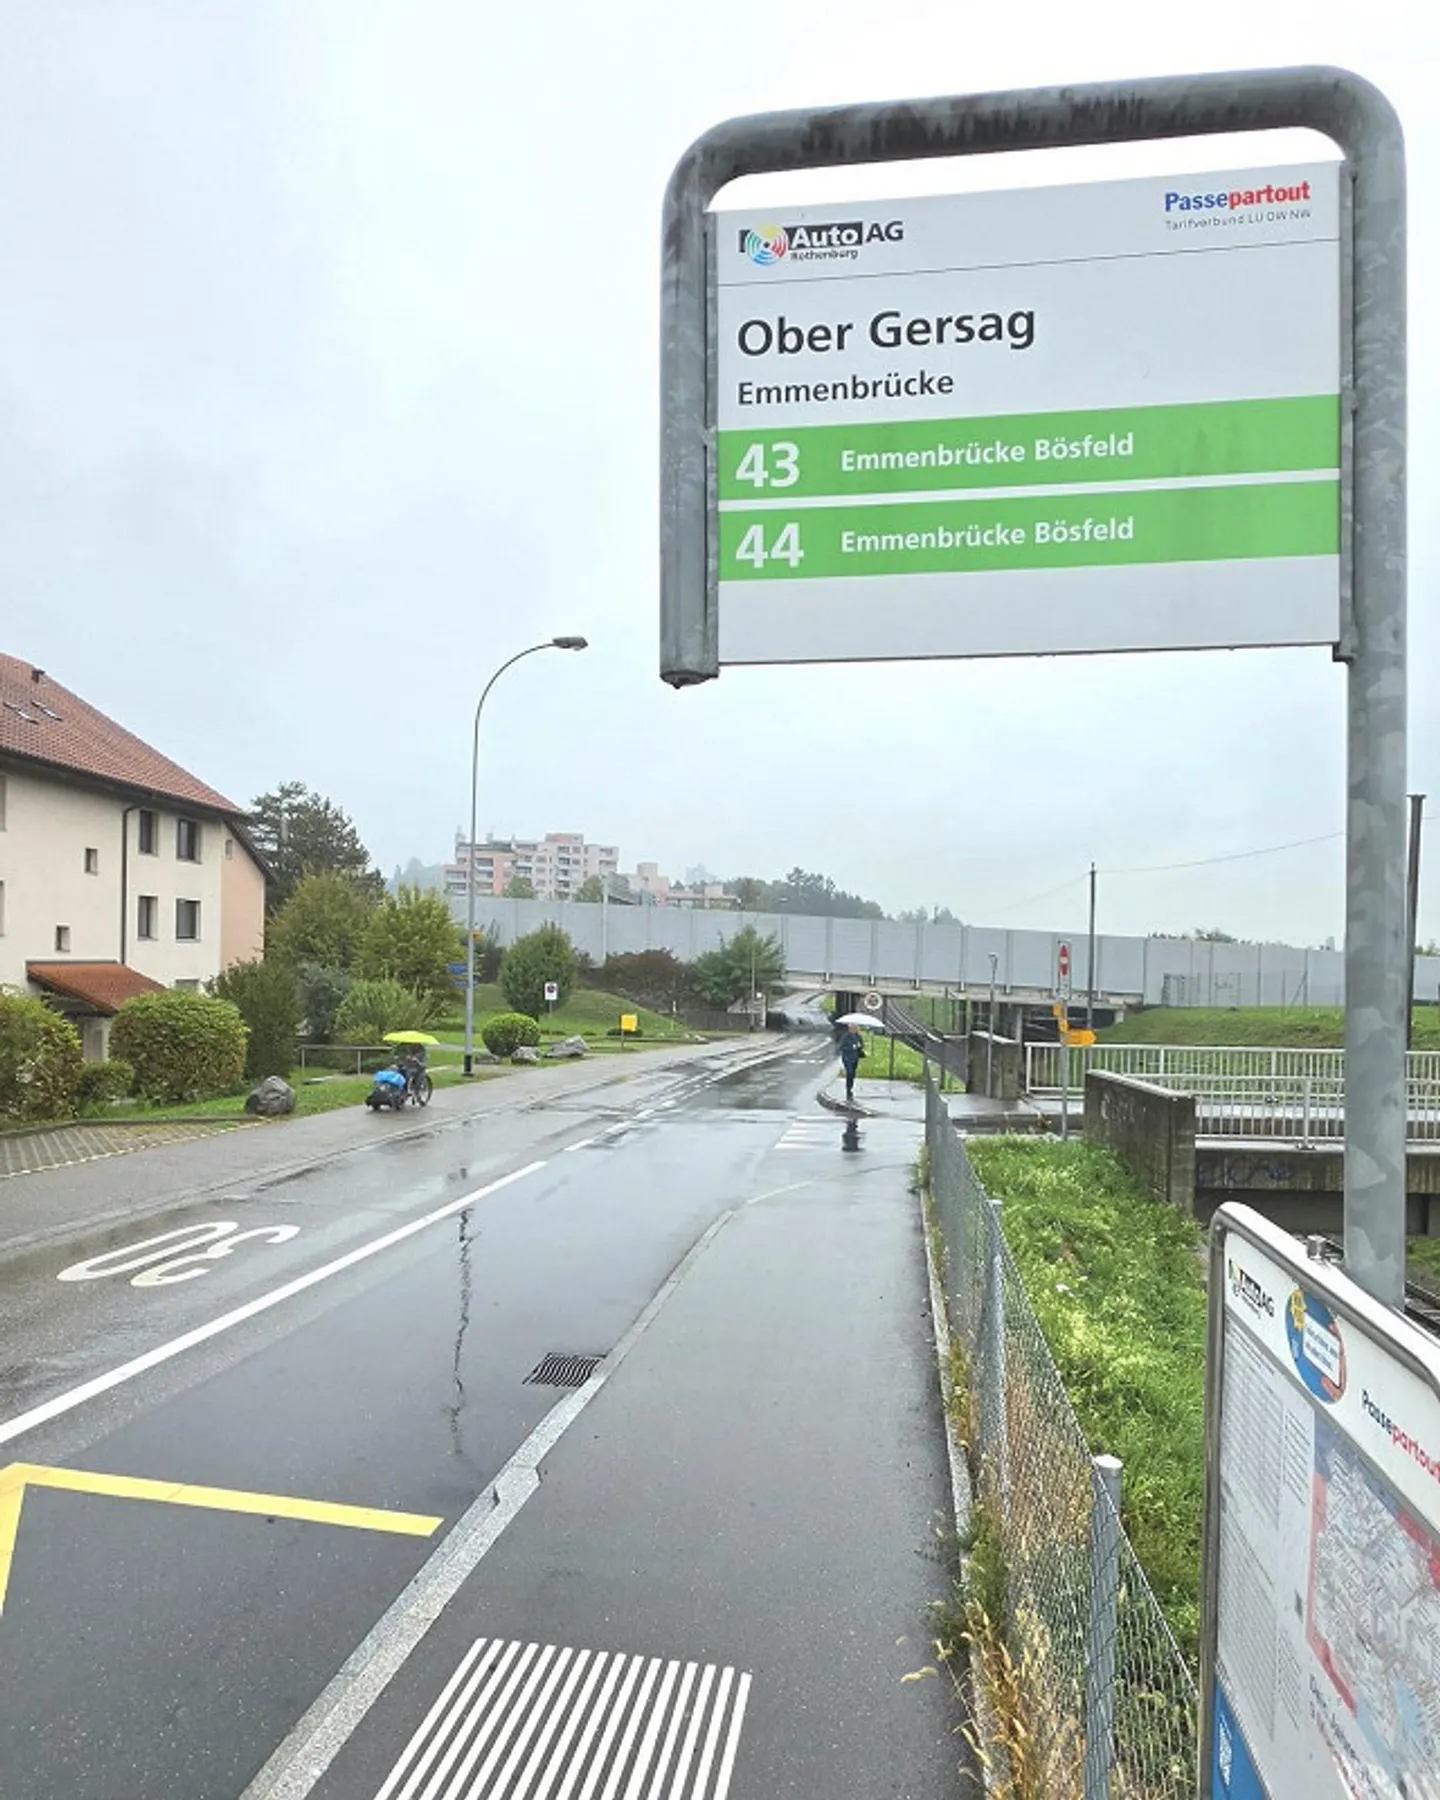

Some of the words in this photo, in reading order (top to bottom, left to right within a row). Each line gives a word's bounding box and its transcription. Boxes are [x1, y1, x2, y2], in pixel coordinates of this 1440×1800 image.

[1165, 181, 1311, 212] Passepartout
[790, 249, 859, 261] Rothenburg
[791, 226, 859, 249] Auto
[866, 220, 904, 243] AG
[737, 315, 854, 357] Ober
[869, 310, 1035, 350] Gersag
[737, 369, 954, 406] Emmenbrücke
[735, 441, 800, 488] 43
[840, 440, 1026, 472] Emmenbrücke
[1033, 432, 1134, 461] Bösfeld
[735, 522, 805, 569] 44
[840, 523, 1026, 553] Emmenbrücke
[1033, 516, 1134, 544] Bösfeld
[56, 1221, 301, 1287] 30
